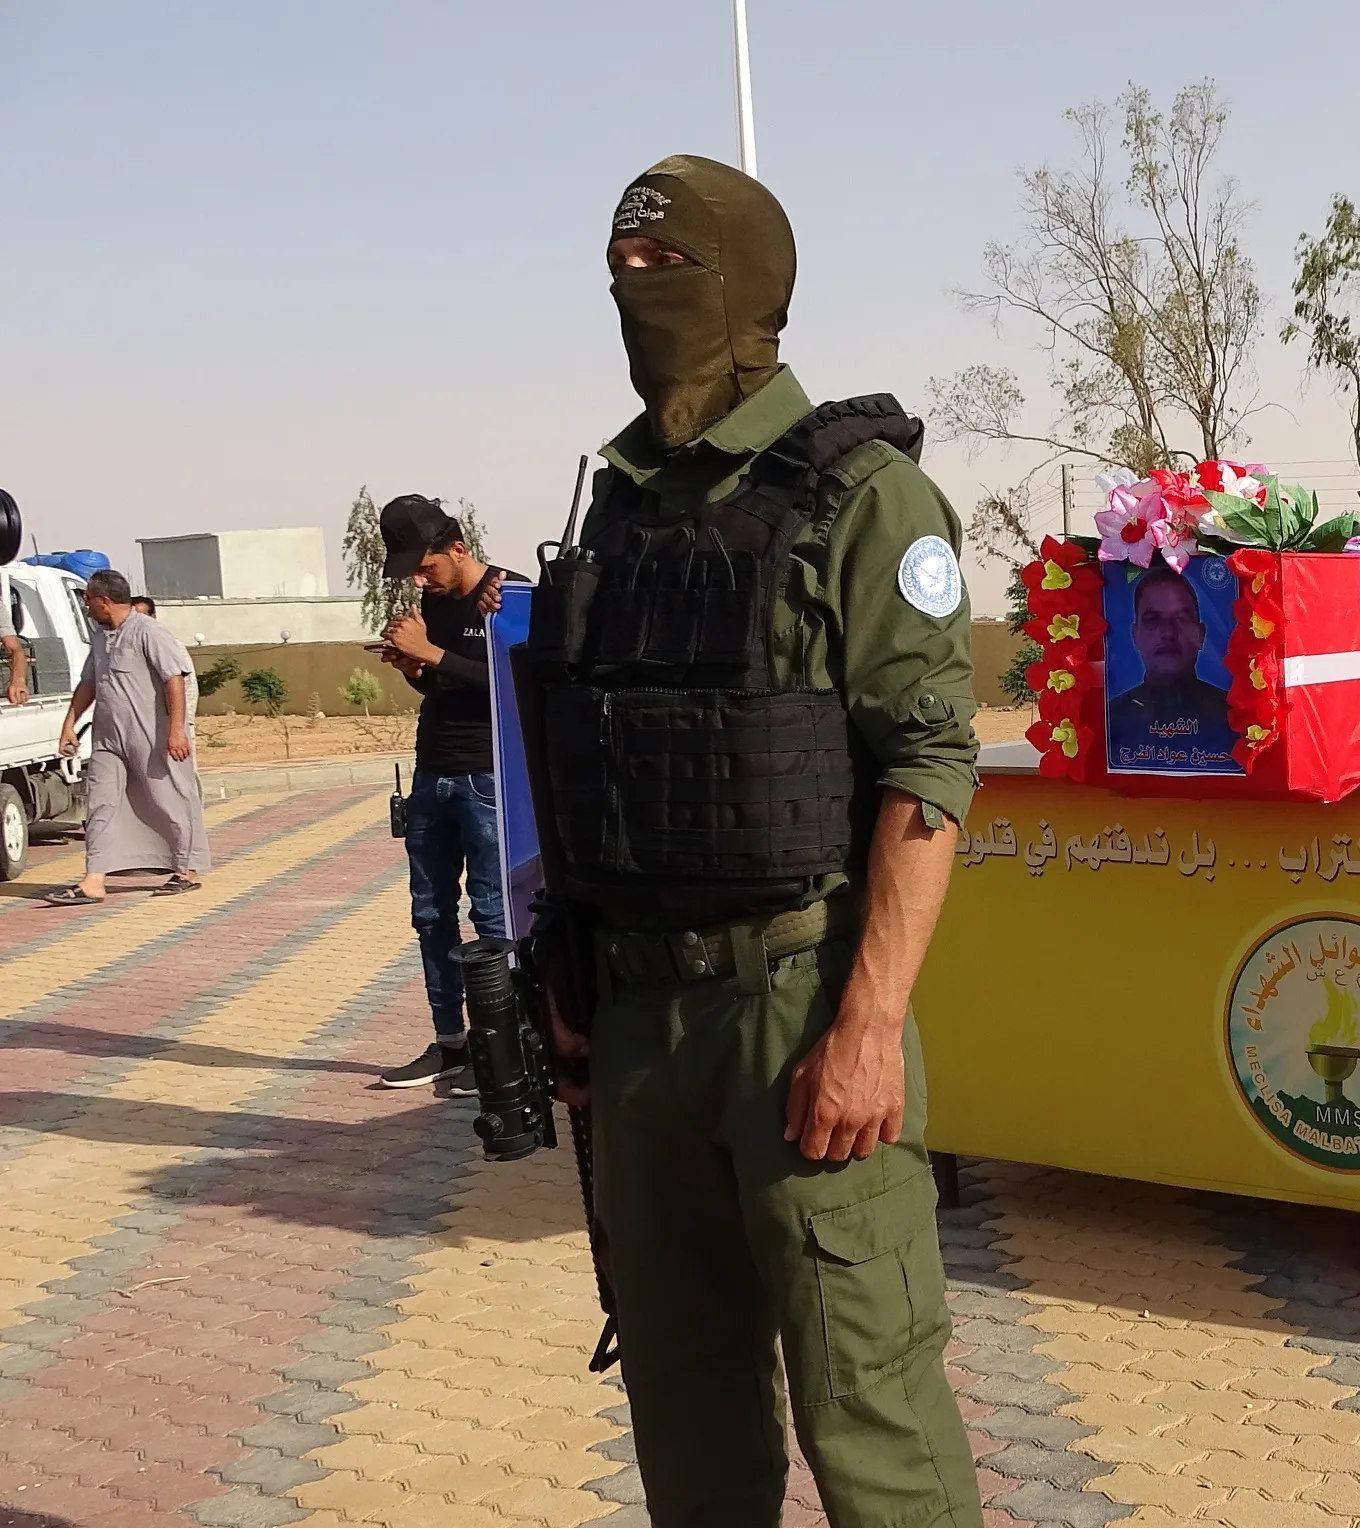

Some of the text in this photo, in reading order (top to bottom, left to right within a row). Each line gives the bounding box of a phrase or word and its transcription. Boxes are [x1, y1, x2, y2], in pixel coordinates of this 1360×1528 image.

[1149, 717, 1199, 738] الشهيد
[1120, 745, 1155, 764] الفرج
[1157, 746, 1188, 764] عواد
[955, 817, 1018, 867] قلوب
[1024, 818, 1057, 878] في
[1065, 823, 1169, 871] ندفنهم
[1177, 830, 1216, 882] بل
[1241, 941, 1302, 1031] الشهداء
[1246, 1046, 1290, 1124] MECLISA
